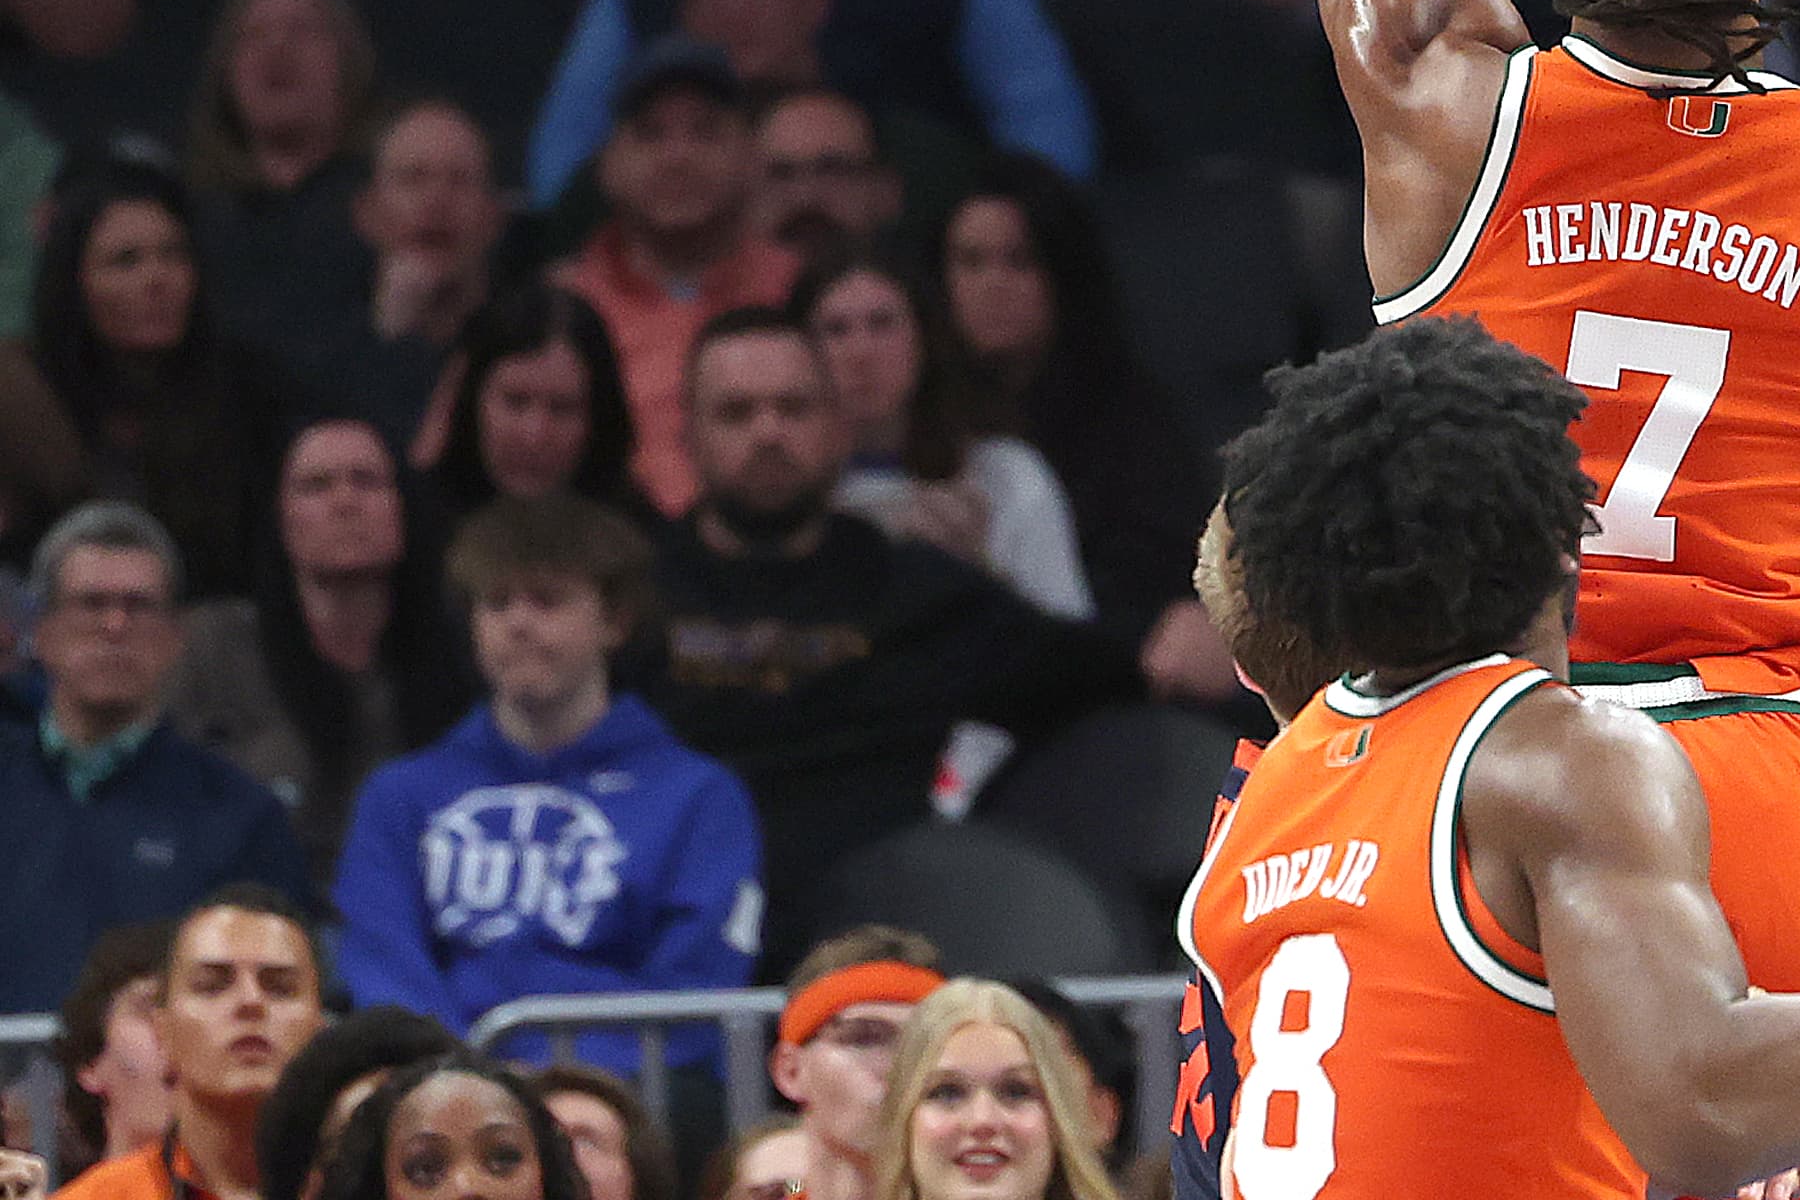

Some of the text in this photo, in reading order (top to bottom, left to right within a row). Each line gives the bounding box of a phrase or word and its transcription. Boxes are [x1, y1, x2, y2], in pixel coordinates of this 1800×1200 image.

[1667, 96, 1731, 138] U
[1565, 310, 1731, 563] 7
[1233, 933, 1351, 1200] 8
